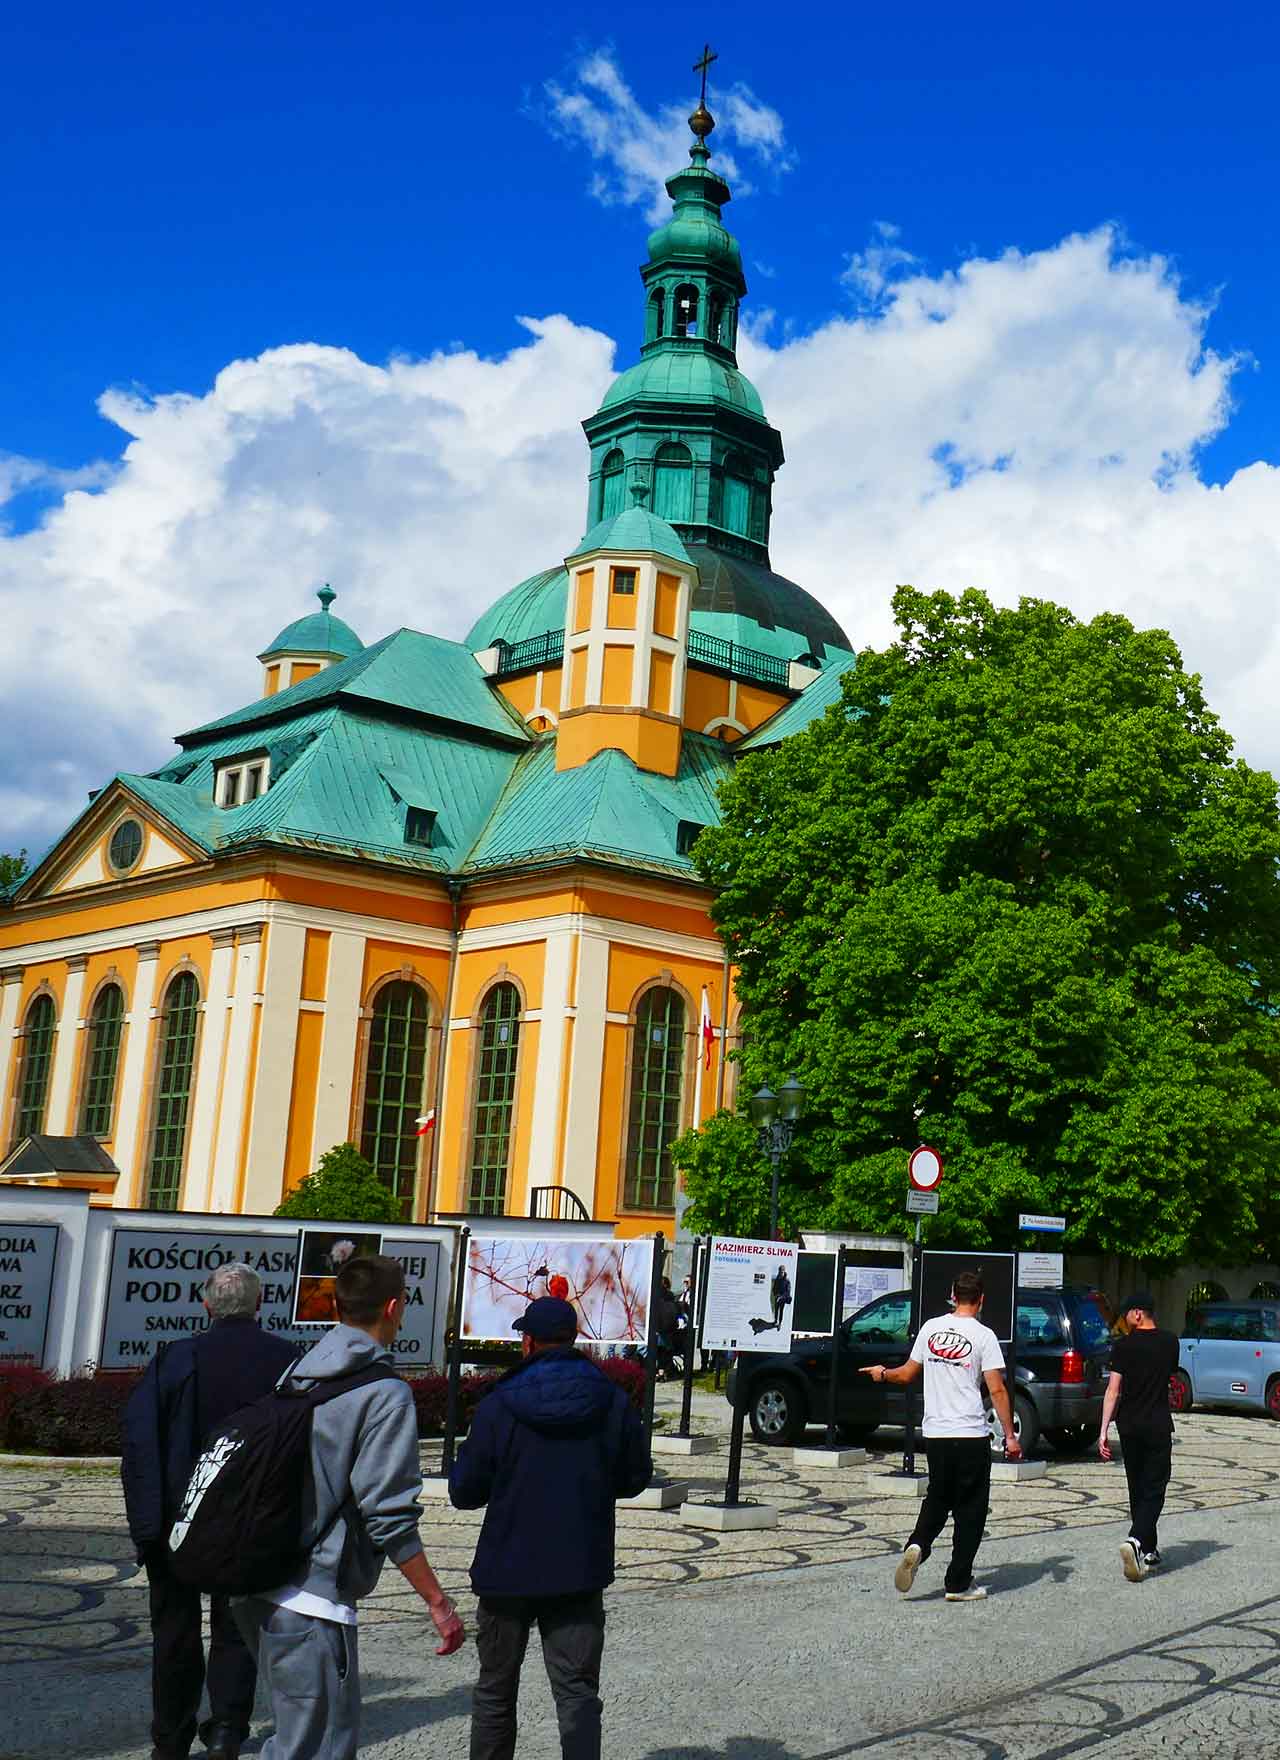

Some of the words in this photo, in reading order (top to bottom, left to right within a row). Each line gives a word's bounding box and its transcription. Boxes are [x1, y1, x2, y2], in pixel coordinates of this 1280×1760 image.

[715, 1242, 764, 1255] KAZIMIERZ
[243, 1250, 296, 1272] ŁASK
[125, 1281, 181, 1303] POD
